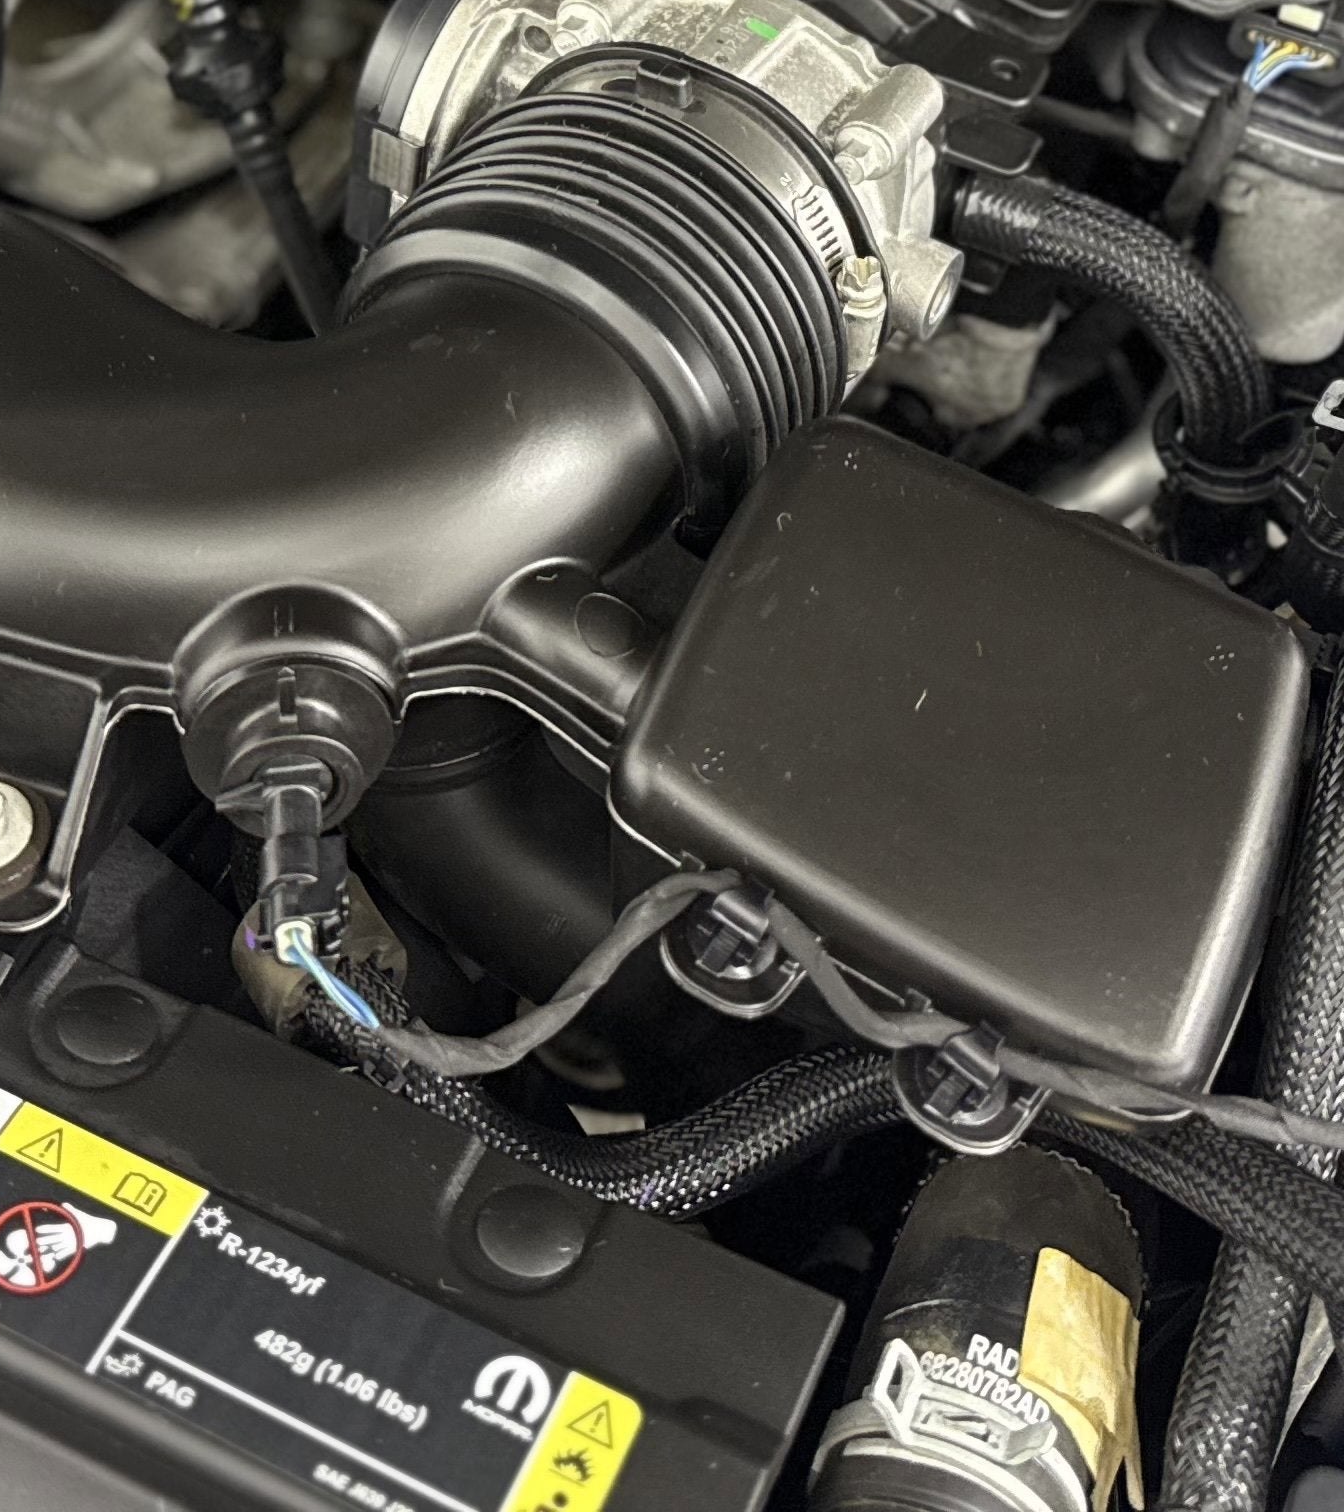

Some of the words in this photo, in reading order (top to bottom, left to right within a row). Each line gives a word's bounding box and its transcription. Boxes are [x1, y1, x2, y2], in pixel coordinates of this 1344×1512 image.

[218, 1232, 327, 1296] R-1234yf
[144, 1370, 197, 1408] PAG
[254, 1329, 315, 1375] 482g
[313, 1358, 378, 1402] (1.06
[376, 1388, 428, 1433] lbs)
[920, 1350, 1050, 1425] 68280782AD
